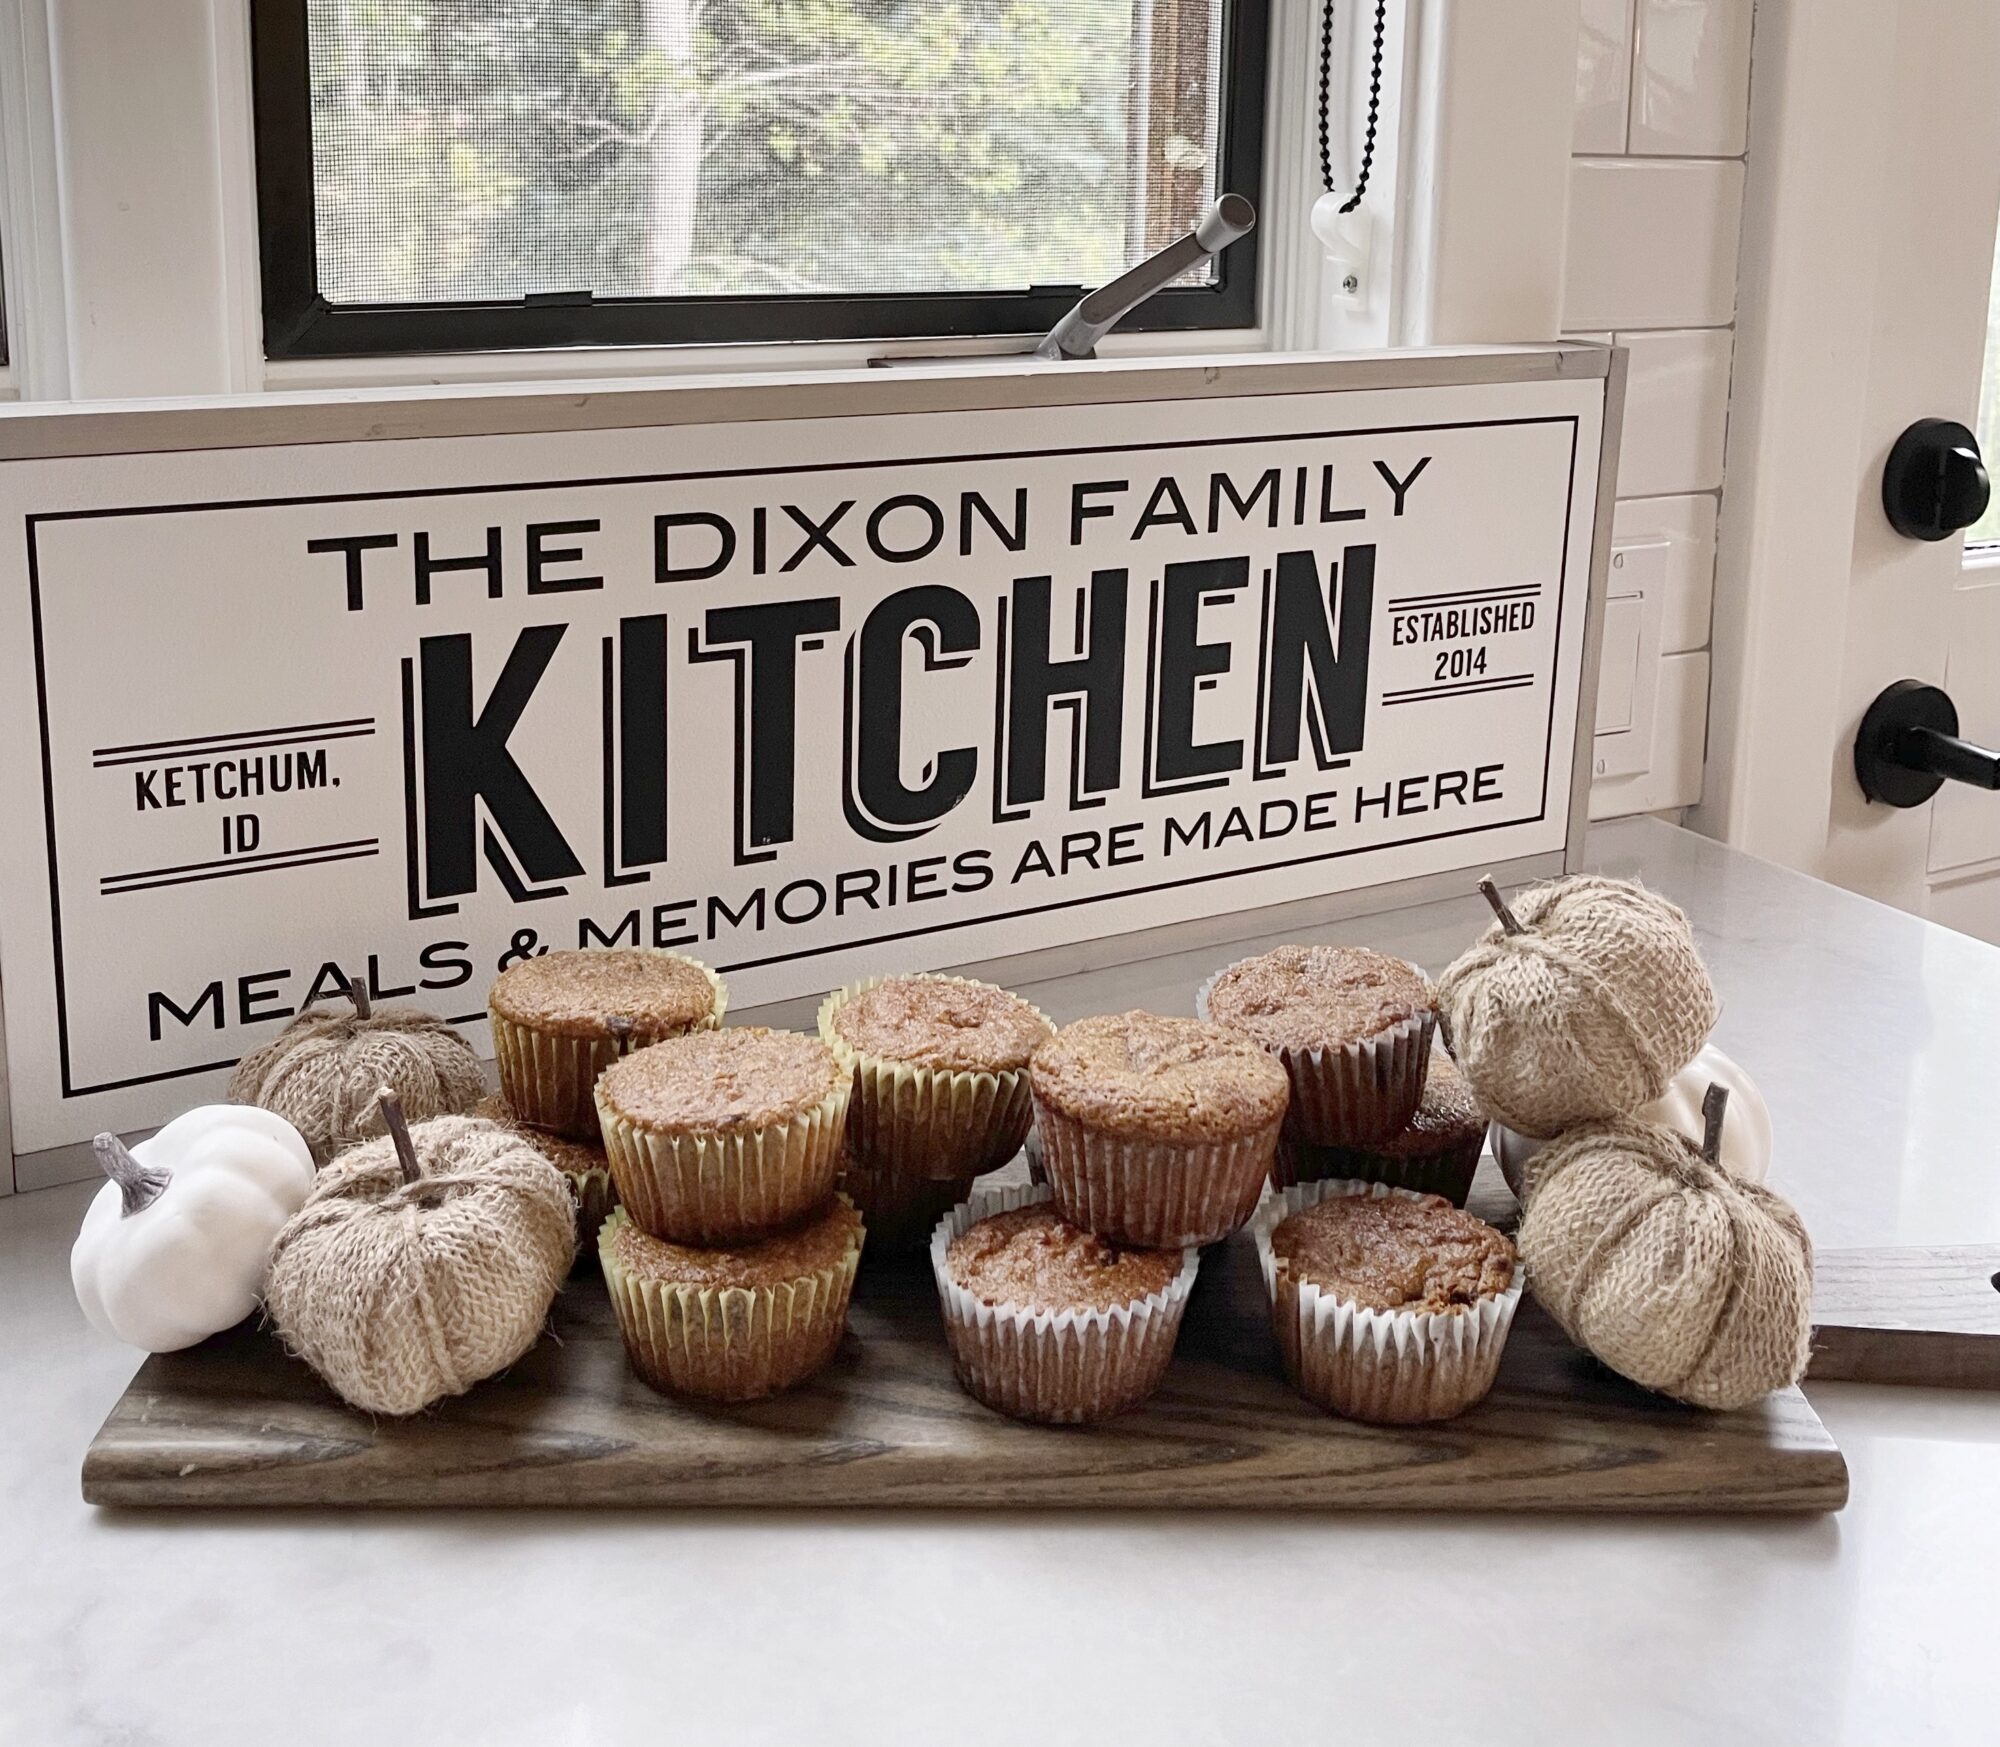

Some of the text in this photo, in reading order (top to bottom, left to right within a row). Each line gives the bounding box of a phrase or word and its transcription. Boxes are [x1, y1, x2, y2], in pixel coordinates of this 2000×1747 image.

[307, 457, 1432, 611] THE DIXON FAMILY
[1392, 601, 1535, 646] ESTABLISHED
[1434, 646, 1488, 681] 2014
[401, 544, 1376, 920] KITCHEN
[135, 748, 341, 811] KETCHUM,
[222, 813, 260, 855] ID
[147, 763, 1505, 1042] MEALS & MEMORIES ARE MADE HERE
